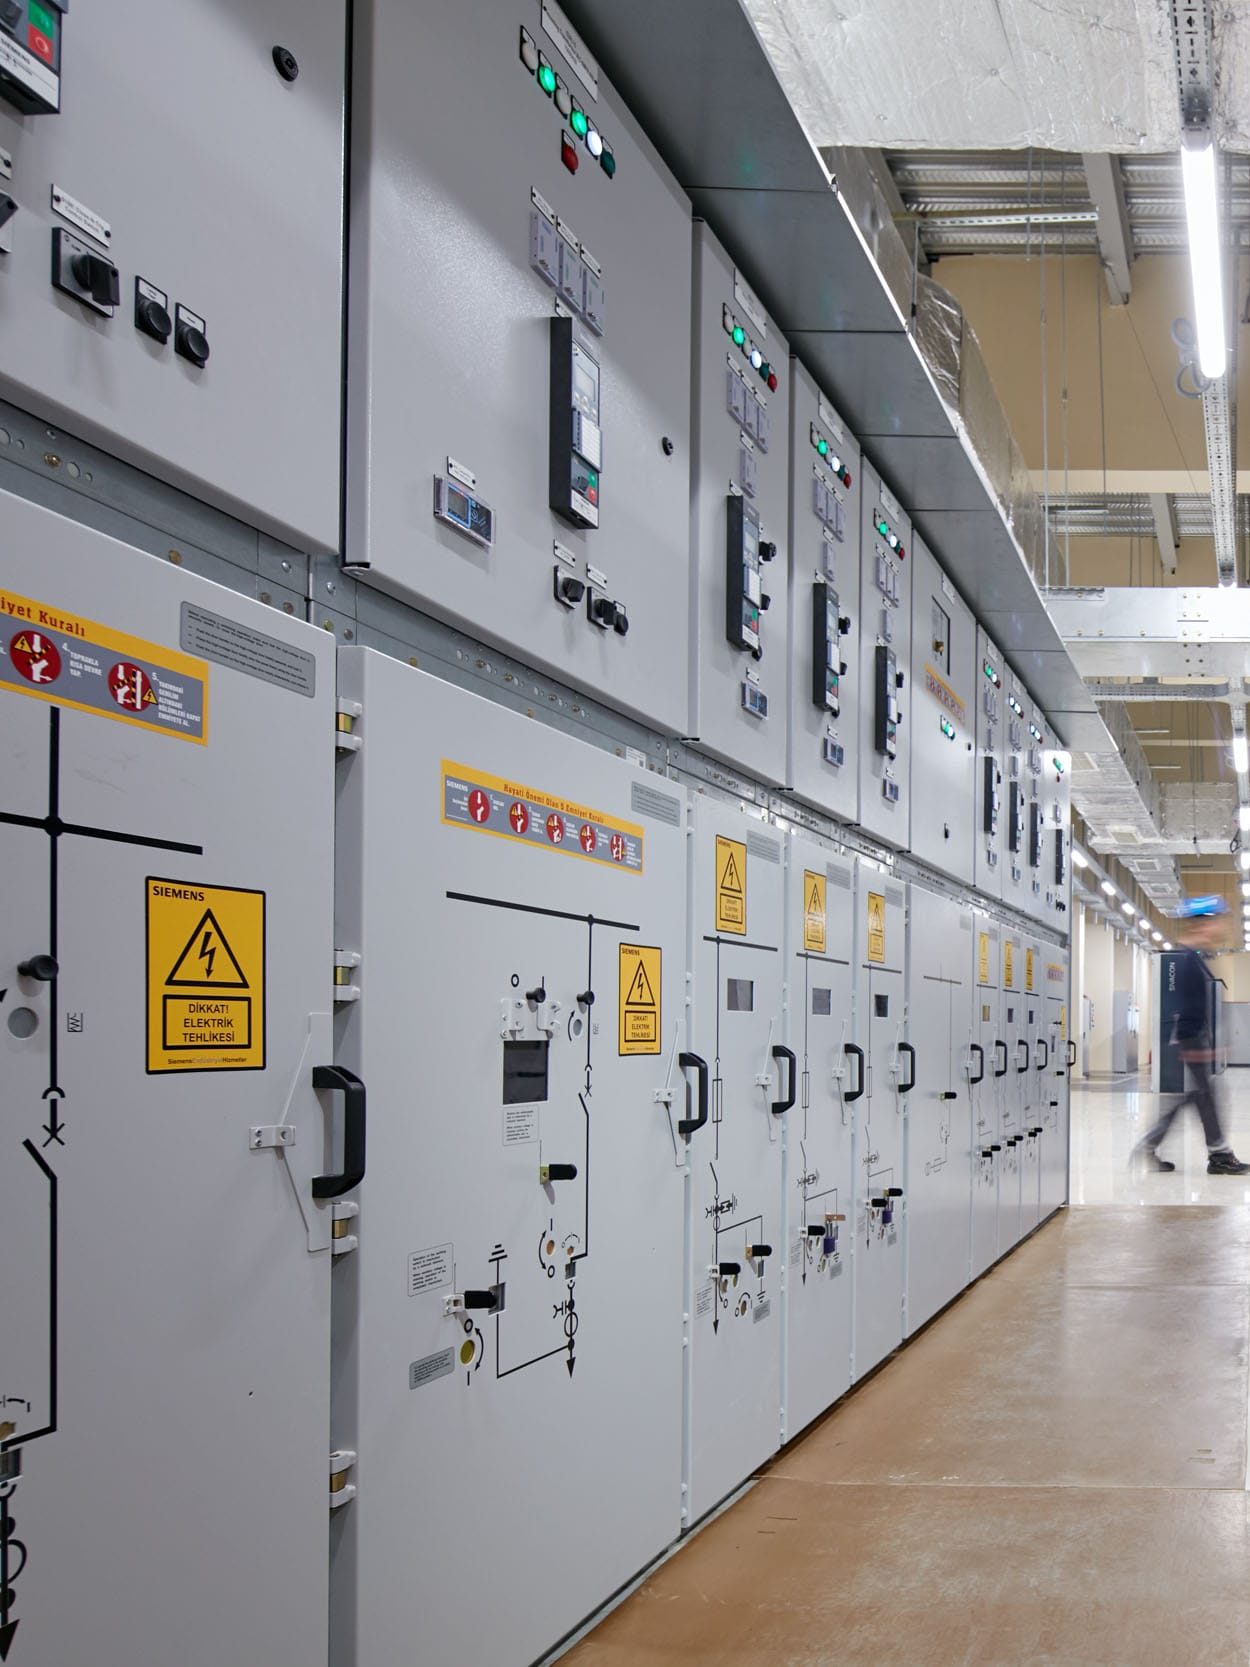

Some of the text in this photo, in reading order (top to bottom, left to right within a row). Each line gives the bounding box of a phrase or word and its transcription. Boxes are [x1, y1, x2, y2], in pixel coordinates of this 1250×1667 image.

[39, 610, 85, 637] Kuralı
[153, 885, 205, 901] SIEMENS
[188, 1002, 229, 1014] DİKKAT!
[183, 1017, 234, 1028] ELEKTRİK
[181, 1031, 235, 1042] TEHLİKESİ
